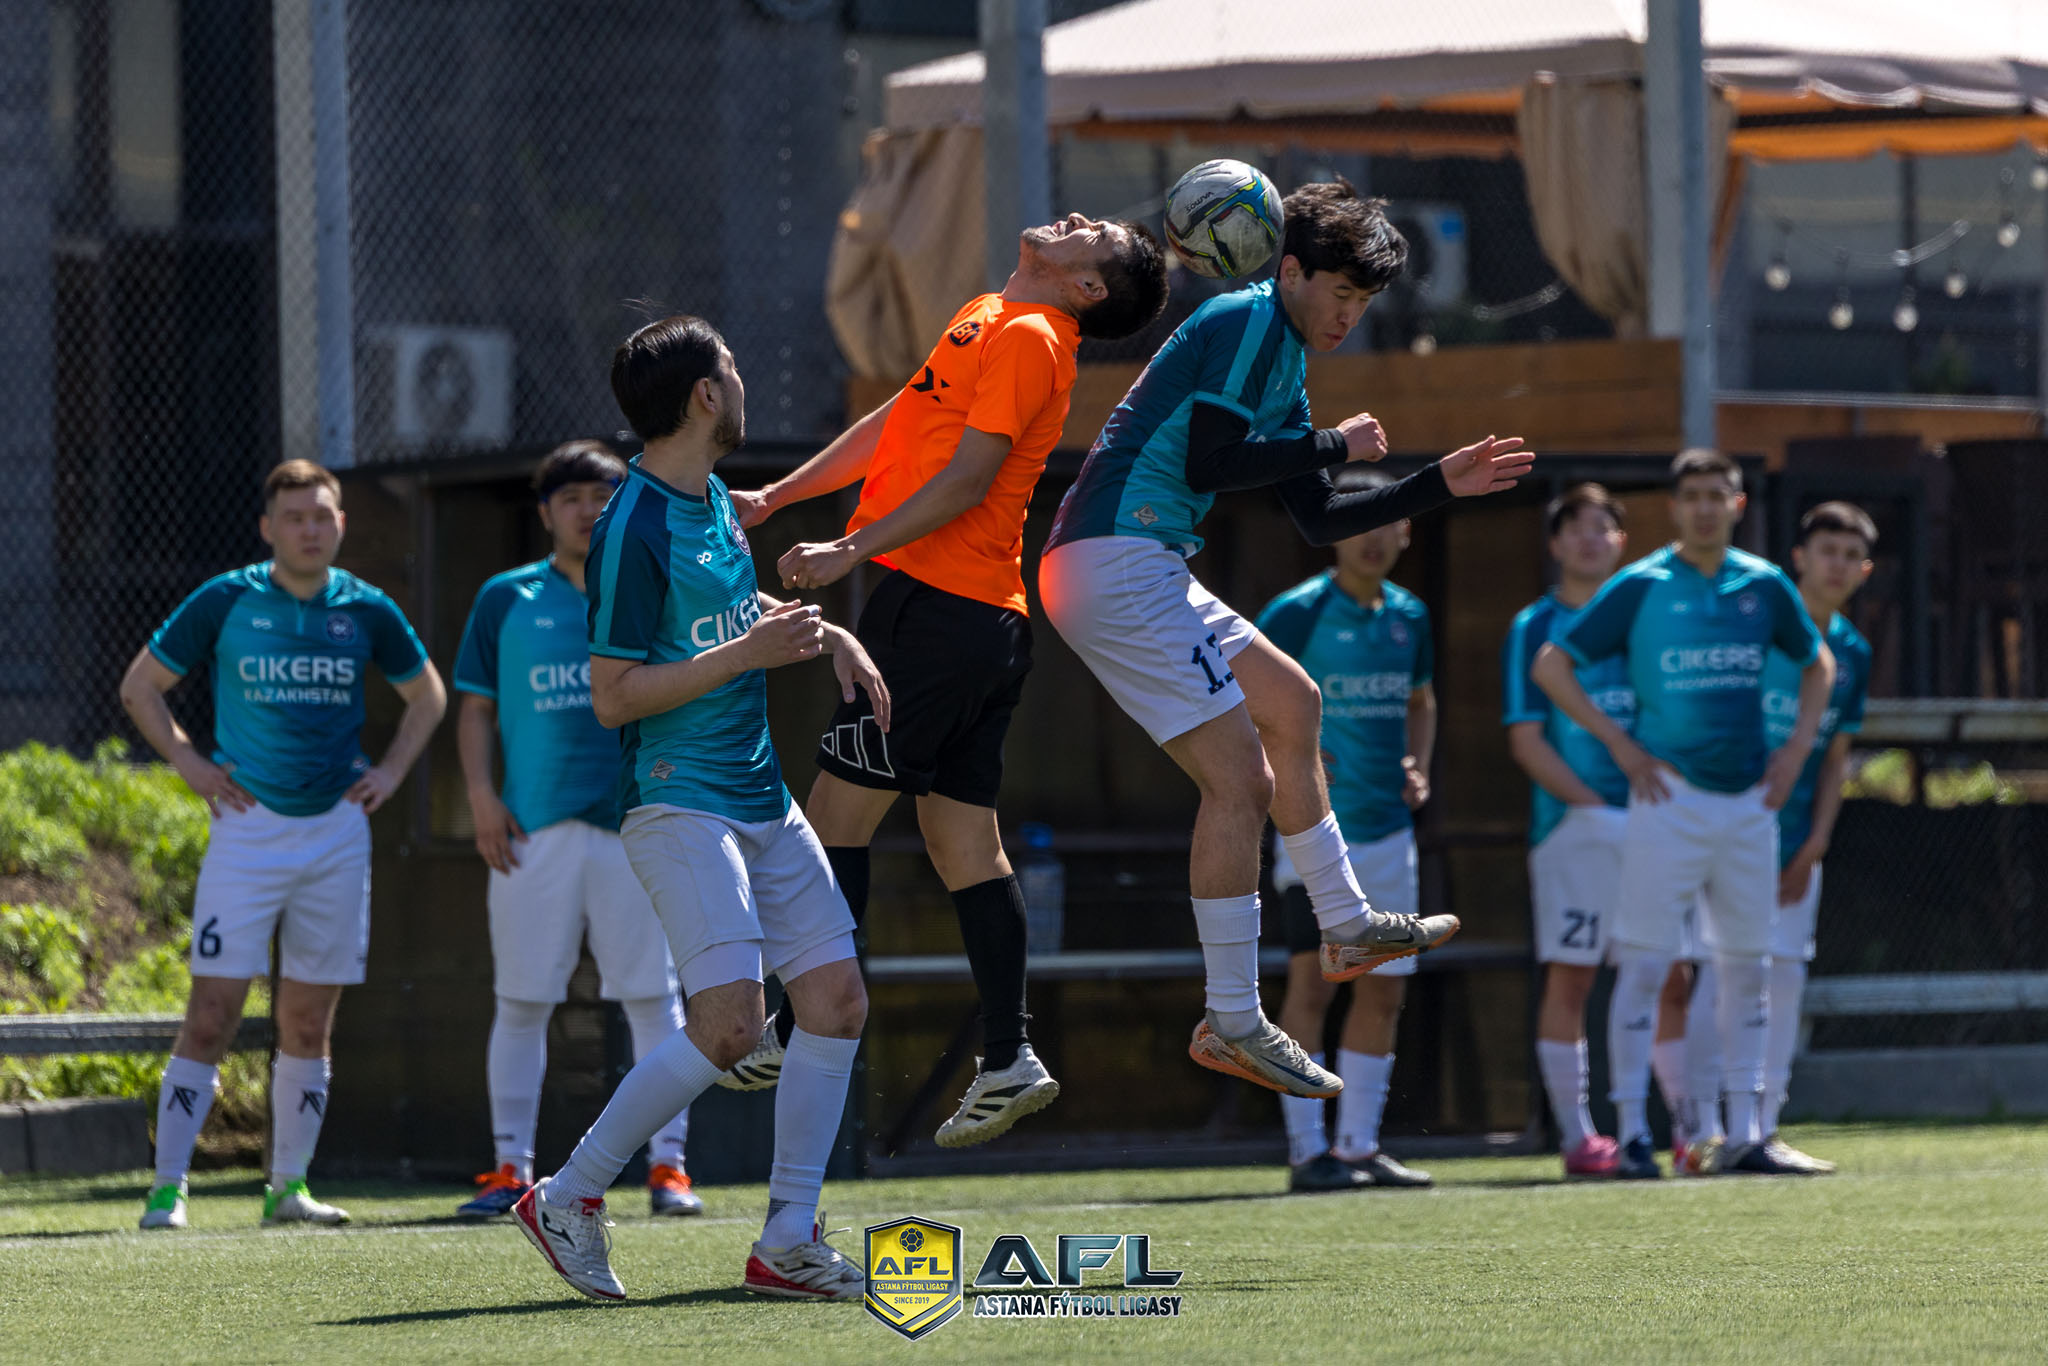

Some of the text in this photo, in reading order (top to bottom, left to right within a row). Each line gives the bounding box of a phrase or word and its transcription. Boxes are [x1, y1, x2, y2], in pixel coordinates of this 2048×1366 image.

[691, 590, 761, 647] CIKER
[239, 656, 355, 685] CIKERS
[199, 916, 221, 958] 6
[1560, 910, 1600, 949] 21
